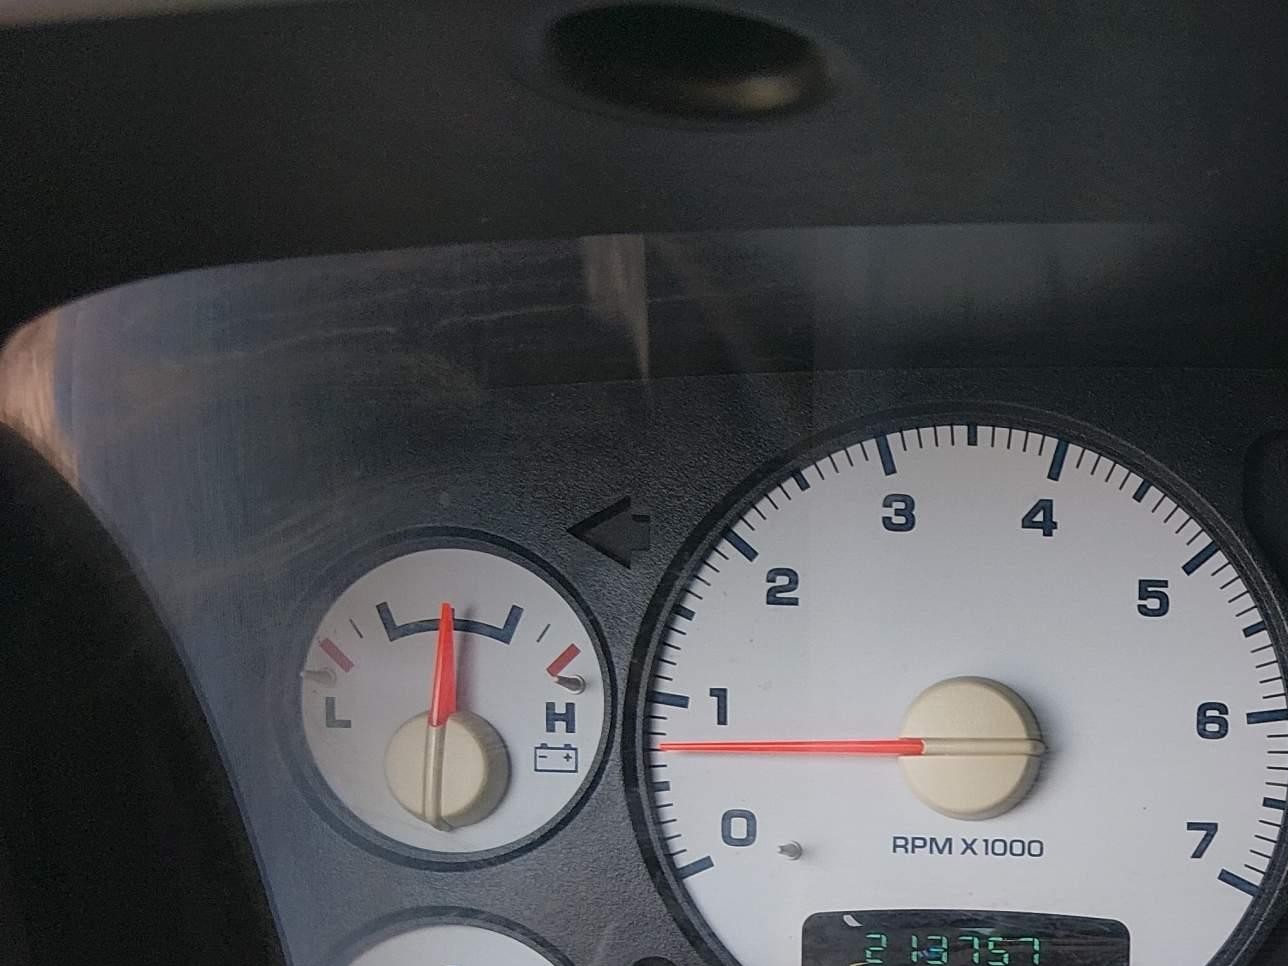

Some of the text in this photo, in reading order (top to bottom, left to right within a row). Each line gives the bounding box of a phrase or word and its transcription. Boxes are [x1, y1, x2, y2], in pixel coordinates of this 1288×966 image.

[882, 494, 915, 532] 3
[1022, 499, 1057, 537] 4
[766, 568, 799, 606] 2
[1137, 579, 1169, 617] 5
[325, 697, 351, 728] L
[546, 702, 575, 733] H
[710, 688, 727, 725] 1
[1197, 702, 1228, 739] 6
[721, 809, 756, 847] 0
[893, 837, 952, 854] RPM
[1187, 822, 1218, 858] 7
[864, 933, 1040, 966] 213757
